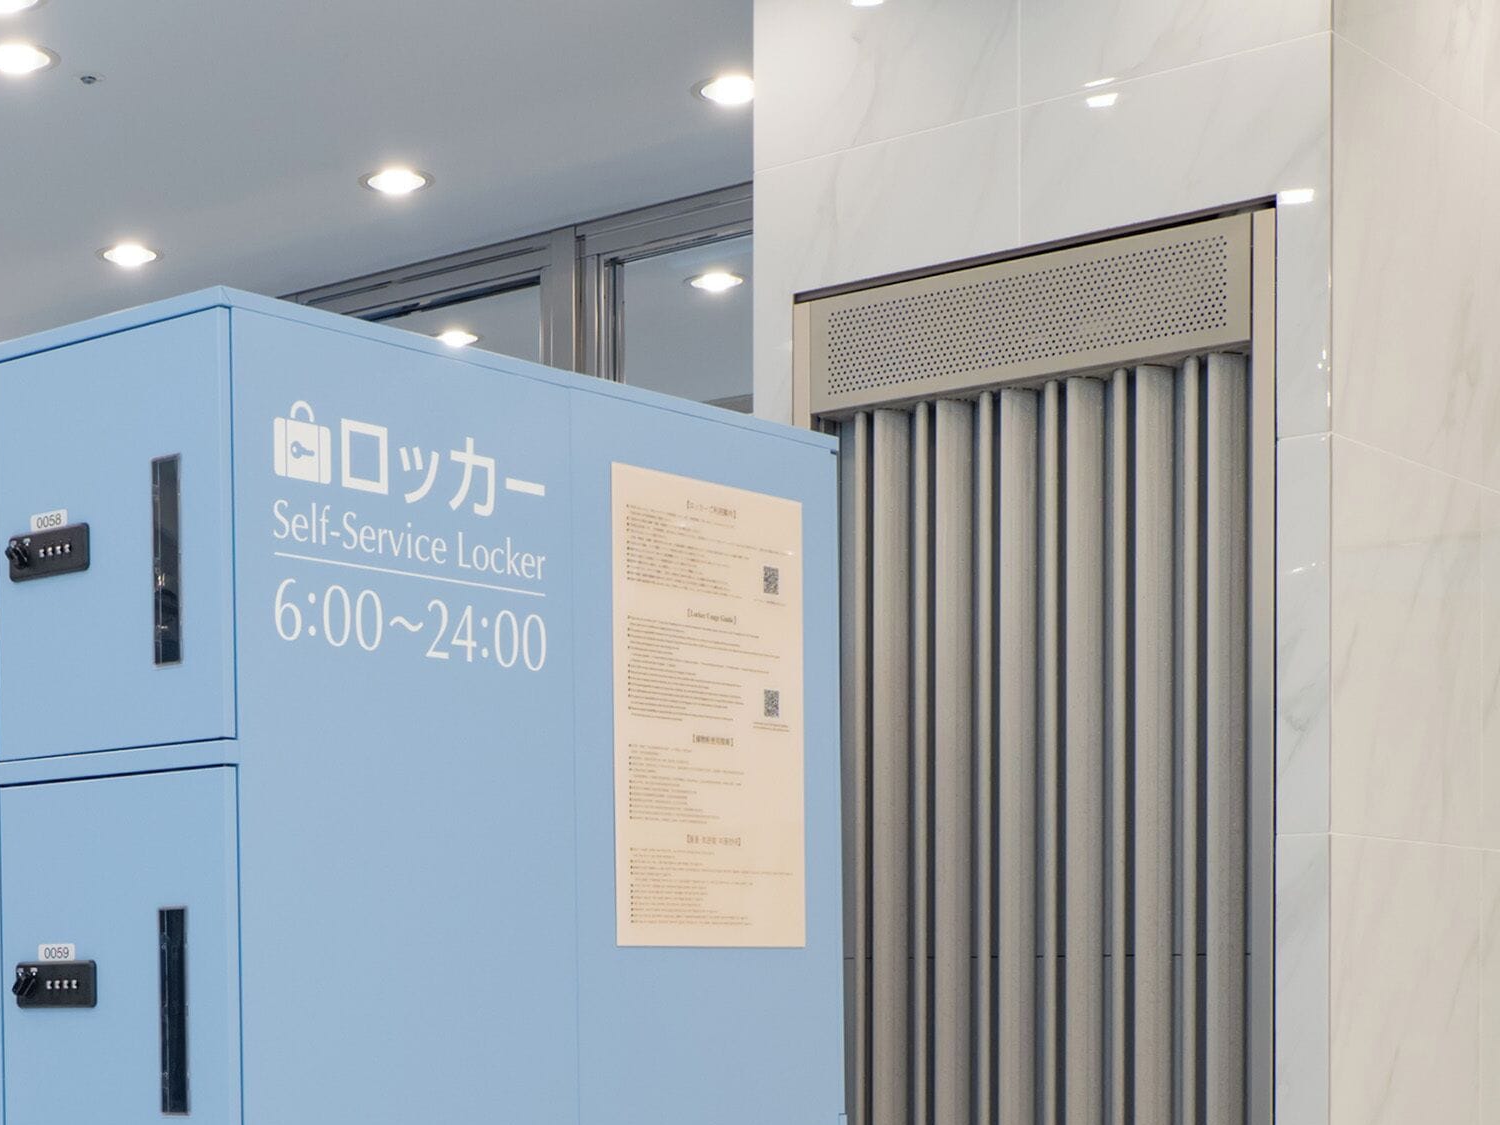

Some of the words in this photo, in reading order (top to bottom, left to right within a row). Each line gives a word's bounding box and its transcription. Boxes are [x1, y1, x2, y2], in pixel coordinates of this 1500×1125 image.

[341, 417, 545, 517] ロッカー
[36, 513, 62, 529] 0058
[273, 499, 447, 564] Self-Service
[457, 531, 546, 580] Locker
[44, 946, 69, 959] 0059
